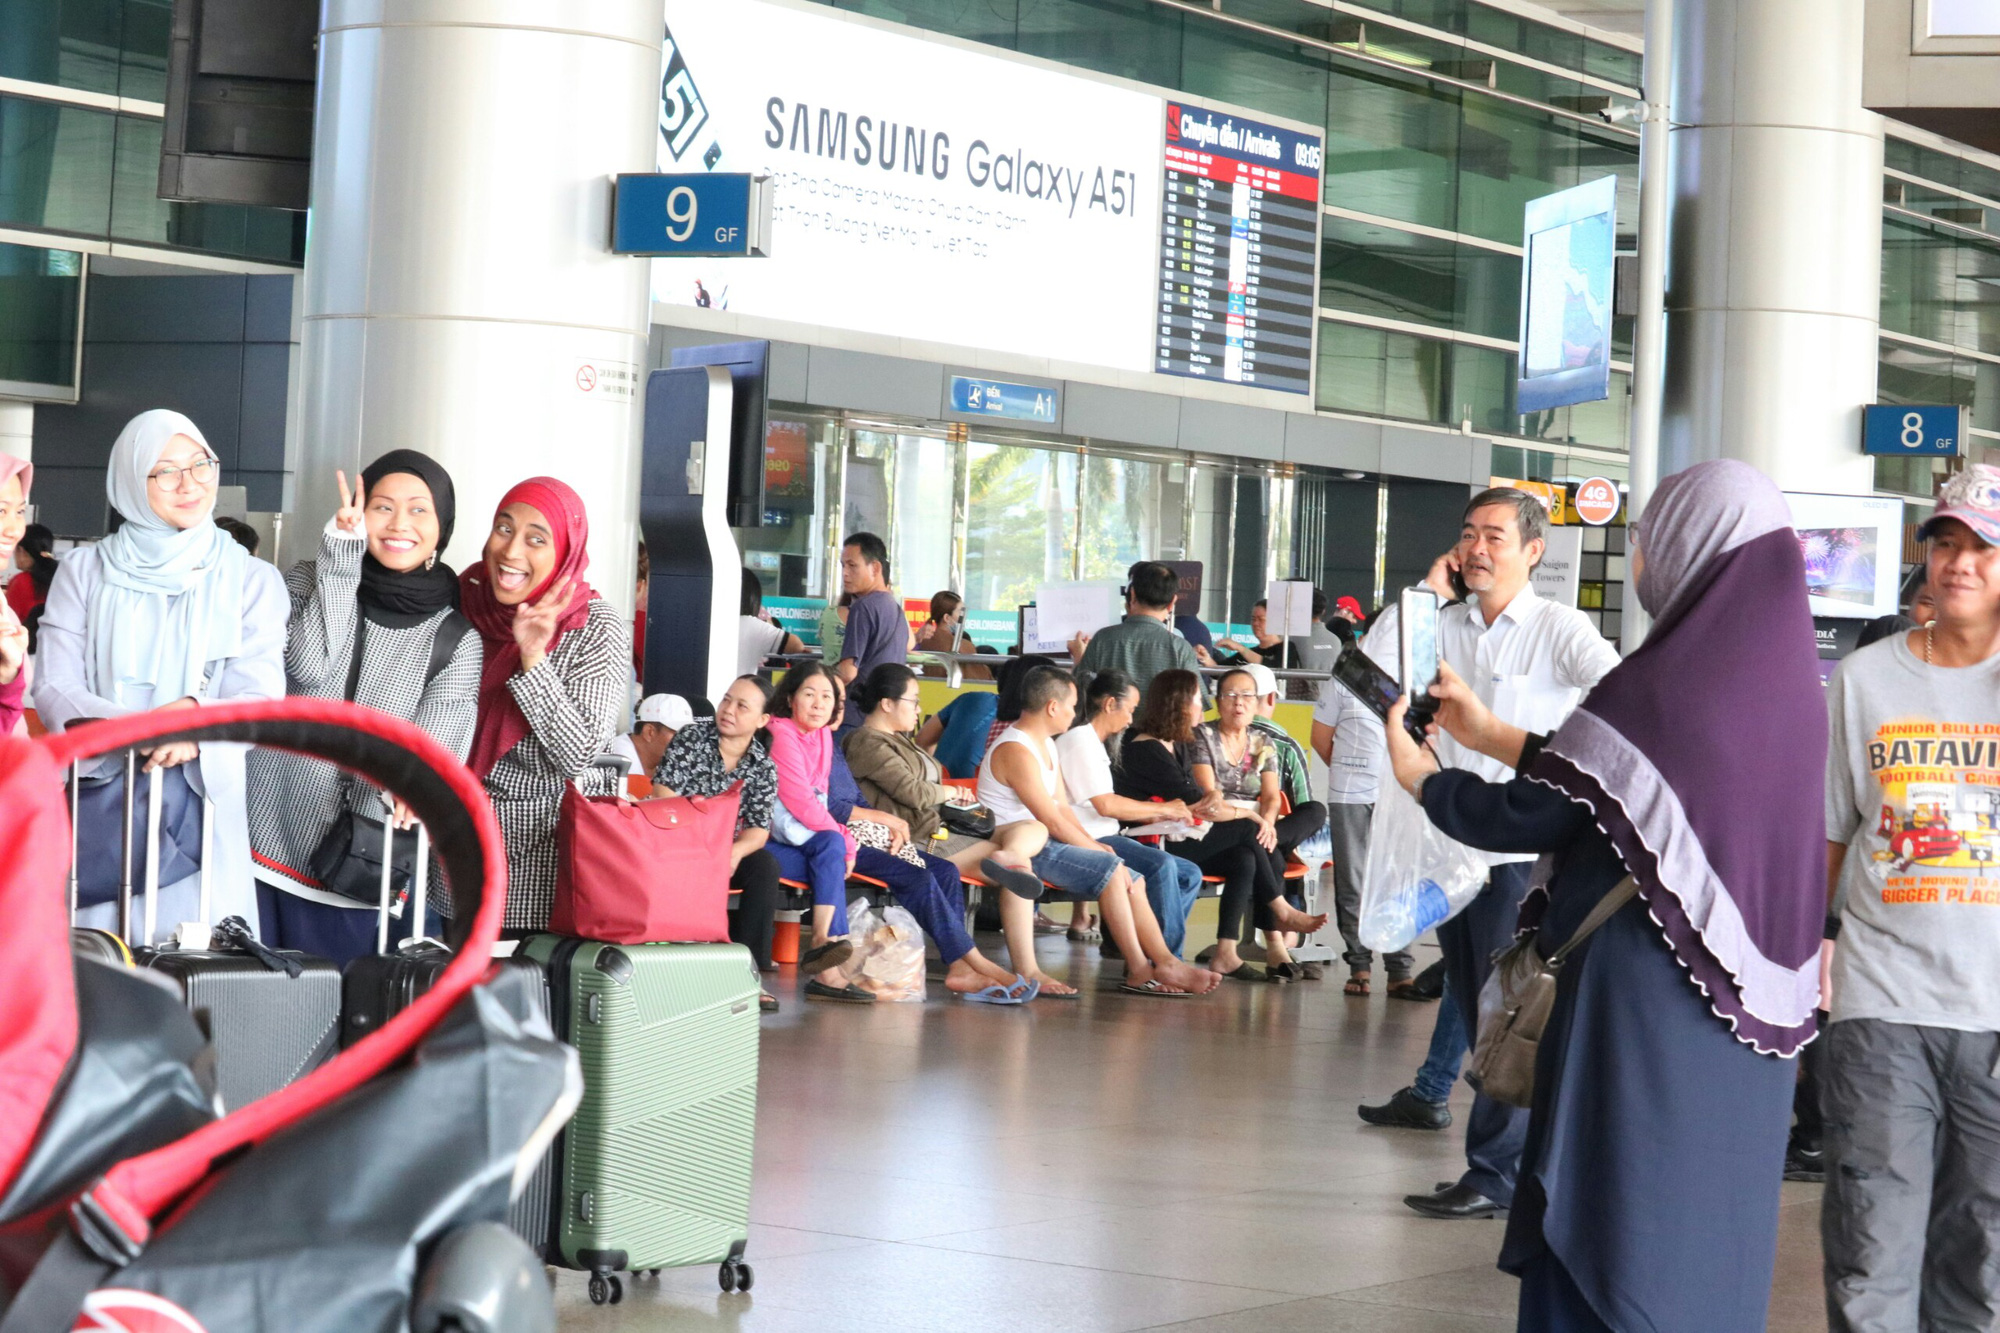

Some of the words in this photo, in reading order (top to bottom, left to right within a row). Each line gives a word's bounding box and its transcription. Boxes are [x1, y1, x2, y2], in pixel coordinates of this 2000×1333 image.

[1244, 129, 1281, 160] Arrivals
[1295, 142, 1320, 169] 09:05
[764, 96, 950, 181] SAMSUNG
[966, 138, 1083, 218] Galaxy
[1088, 166, 1136, 218] A51
[665, 186, 698, 242] 9
[715, 227, 738, 243] GF
[985, 401, 1003, 411] Arrival
[1033, 392, 1052, 417] A1
[1900, 411, 1924, 449] 8
[1936, 437, 1952, 450] GF
[1584, 485, 1608, 500] 4G
[1578, 499, 1613, 510] SIMCARD
[1541, 559, 1569, 570] Saigon
[1535, 572, 1566, 582] Towers
[767, 606, 822, 621] KIENLONGBAN
[964, 619, 1016, 631] IENLONGBANK
[1876, 723, 1936, 736] JUNIOR
[1879, 771, 1958, 785] FOOTBALL
[1887, 876, 1916, 887] WE'RE
[1920, 876, 1969, 887] MOVING
[1974, 877, 1988, 887] TO
[1881, 887, 1940, 904] BIGGER
